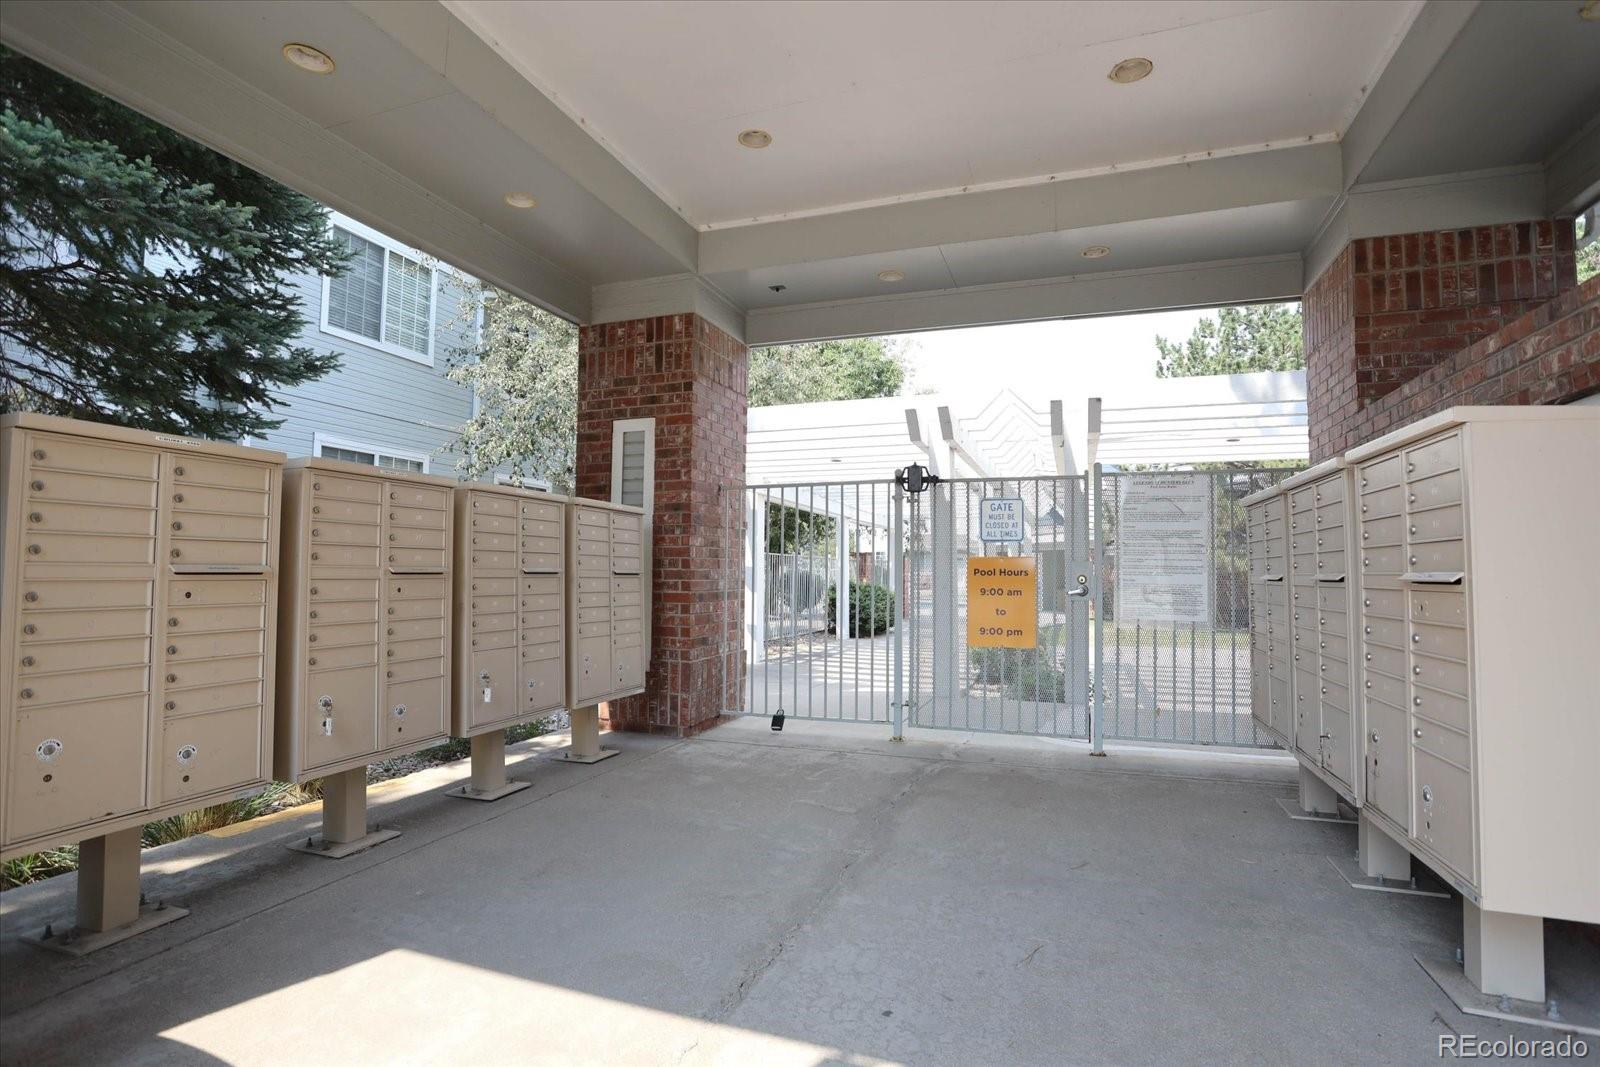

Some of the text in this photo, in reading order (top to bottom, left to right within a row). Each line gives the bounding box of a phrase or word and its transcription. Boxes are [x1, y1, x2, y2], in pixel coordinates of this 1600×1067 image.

[990, 503, 1014, 512] GATE
[973, 568, 1029, 577] Pool Hours
[980, 588, 1022, 597] 9:00 am
[996, 608, 1007, 616] to
[979, 627, 1023, 637] 9:00 pm
